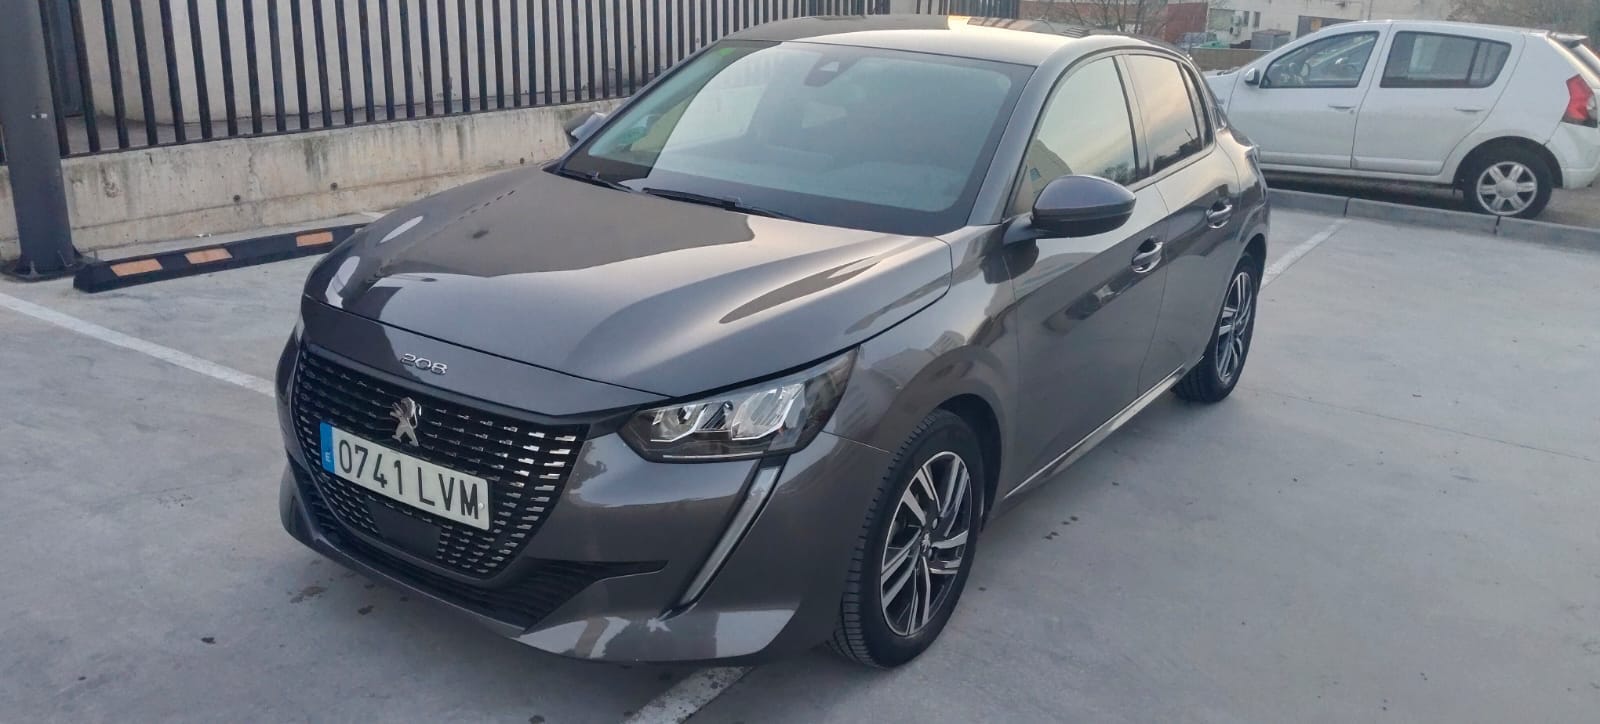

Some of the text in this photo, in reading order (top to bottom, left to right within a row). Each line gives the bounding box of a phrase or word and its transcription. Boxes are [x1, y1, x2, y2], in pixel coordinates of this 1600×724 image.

[401, 353, 447, 375] 208
[339, 439, 479, 520] 0741 LVM
